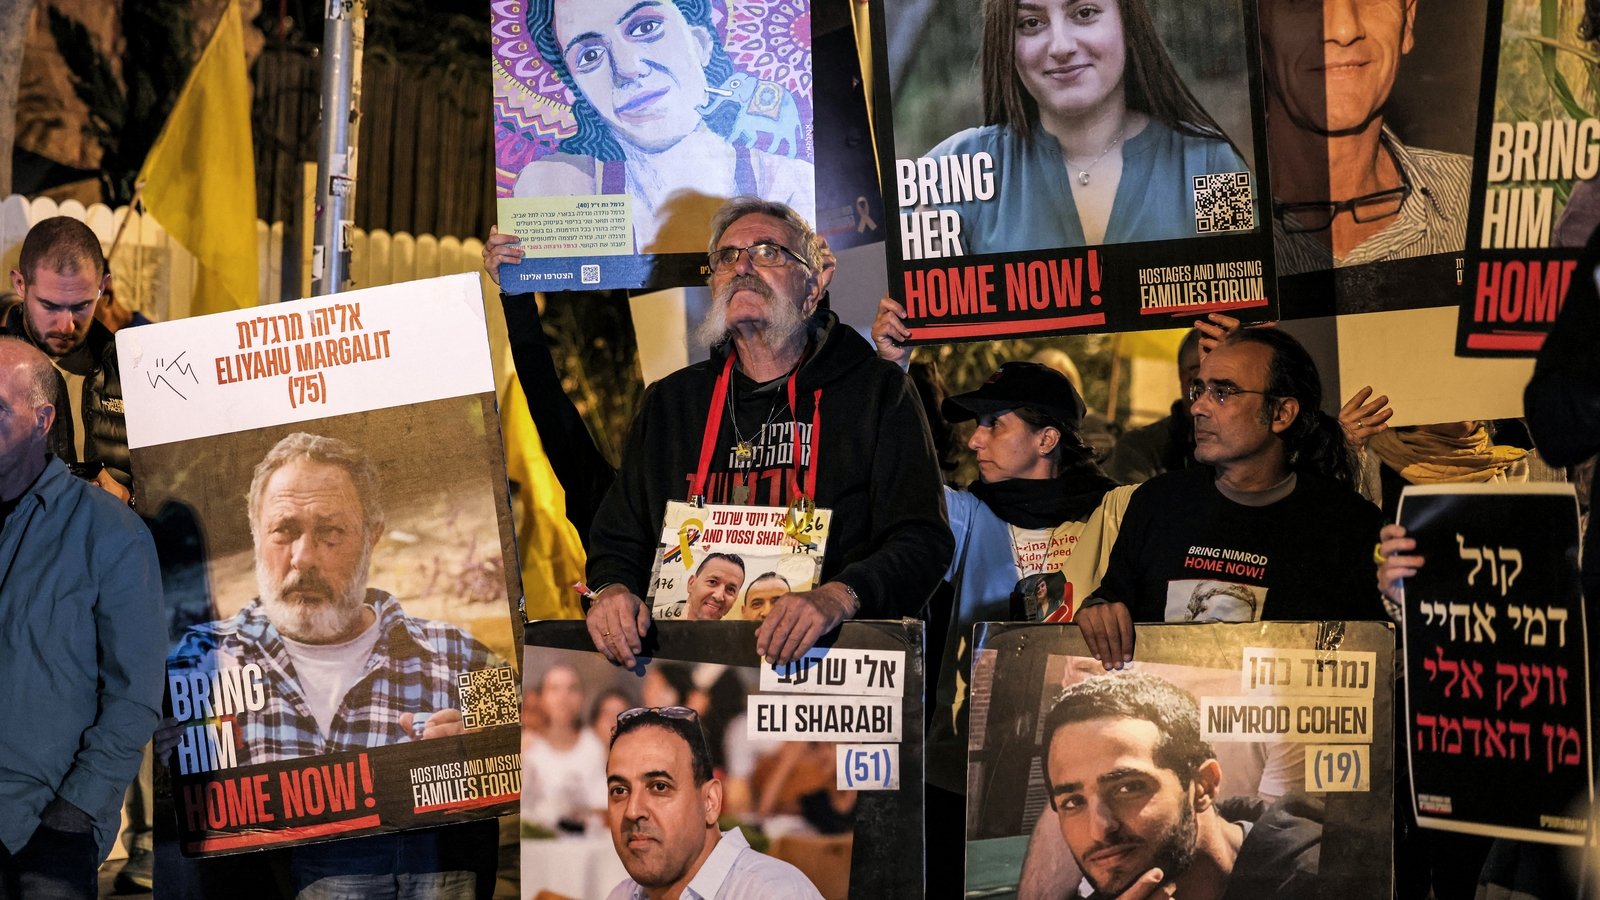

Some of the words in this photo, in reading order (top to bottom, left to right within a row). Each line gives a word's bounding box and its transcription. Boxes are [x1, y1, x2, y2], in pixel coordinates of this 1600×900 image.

[1488, 118, 1600, 182] BRING
[896, 152, 995, 207] BRING
[900, 209, 963, 261] HER
[1481, 187, 1553, 249] HIM
[544, 272, 573, 280] הצטרפו
[904, 264, 997, 319] HOME
[1004, 250, 1102, 312] NOW!
[1140, 265, 1191, 285] HOSTAGES
[1194, 264, 1214, 280] AND
[1216, 260, 1262, 279] MISSING
[1141, 282, 1207, 308] FAMILIES
[1210, 277, 1264, 304] FORUM
[236, 312, 304, 349] מרגלית
[308, 302, 363, 338] אליהו
[215, 347, 292, 385] ELIYAHU
[294, 330, 391, 373] MARGALIT
[288, 372, 327, 408] (75)
[702, 529, 722, 543] AND
[726, 530, 755, 545] YOSSI
[712, 511, 742, 526] שרעבי
[745, 512, 768, 527] ויוסי
[1184, 556, 1224, 572] HOME
[1226, 562, 1265, 580] NOW!
[1188, 546, 1220, 558] BRING
[1222, 549, 1268, 566] NIMROD
[1456, 532, 1523, 596] קול
[660, 606, 682, 618] 166
[1420, 600, 1496, 644] אחיי
[1508, 603, 1568, 648] דמי
[772, 656, 847, 686] שרעב
[855, 654, 896, 688] אלי
[1250, 656, 1292, 690] כהן
[1300, 658, 1370, 689] נמרוד
[1424, 645, 1484, 700] אלי
[1496, 660, 1568, 711] זועק
[170, 663, 266, 723] BRING
[757, 704, 787, 732] ELI
[795, 704, 892, 734] SHARABI
[1208, 705, 1290, 734] NIMROD
[1296, 706, 1367, 735] COHEN
[1416, 712, 1530, 762] האדמה
[178, 720, 238, 775] HIM
[1542, 722, 1581, 774] מן
[410, 762, 462, 784] HOSTAGES
[464, 759, 484, 777] AND
[485, 753, 522, 774] MISSIN
[844, 748, 892, 788] (51)
[1314, 750, 1361, 789] (19)
[183, 773, 275, 832] HOME
[280, 752, 376, 819] NOW!
[412, 776, 478, 808] FAMILIES
[480, 770, 522, 798] FORU
